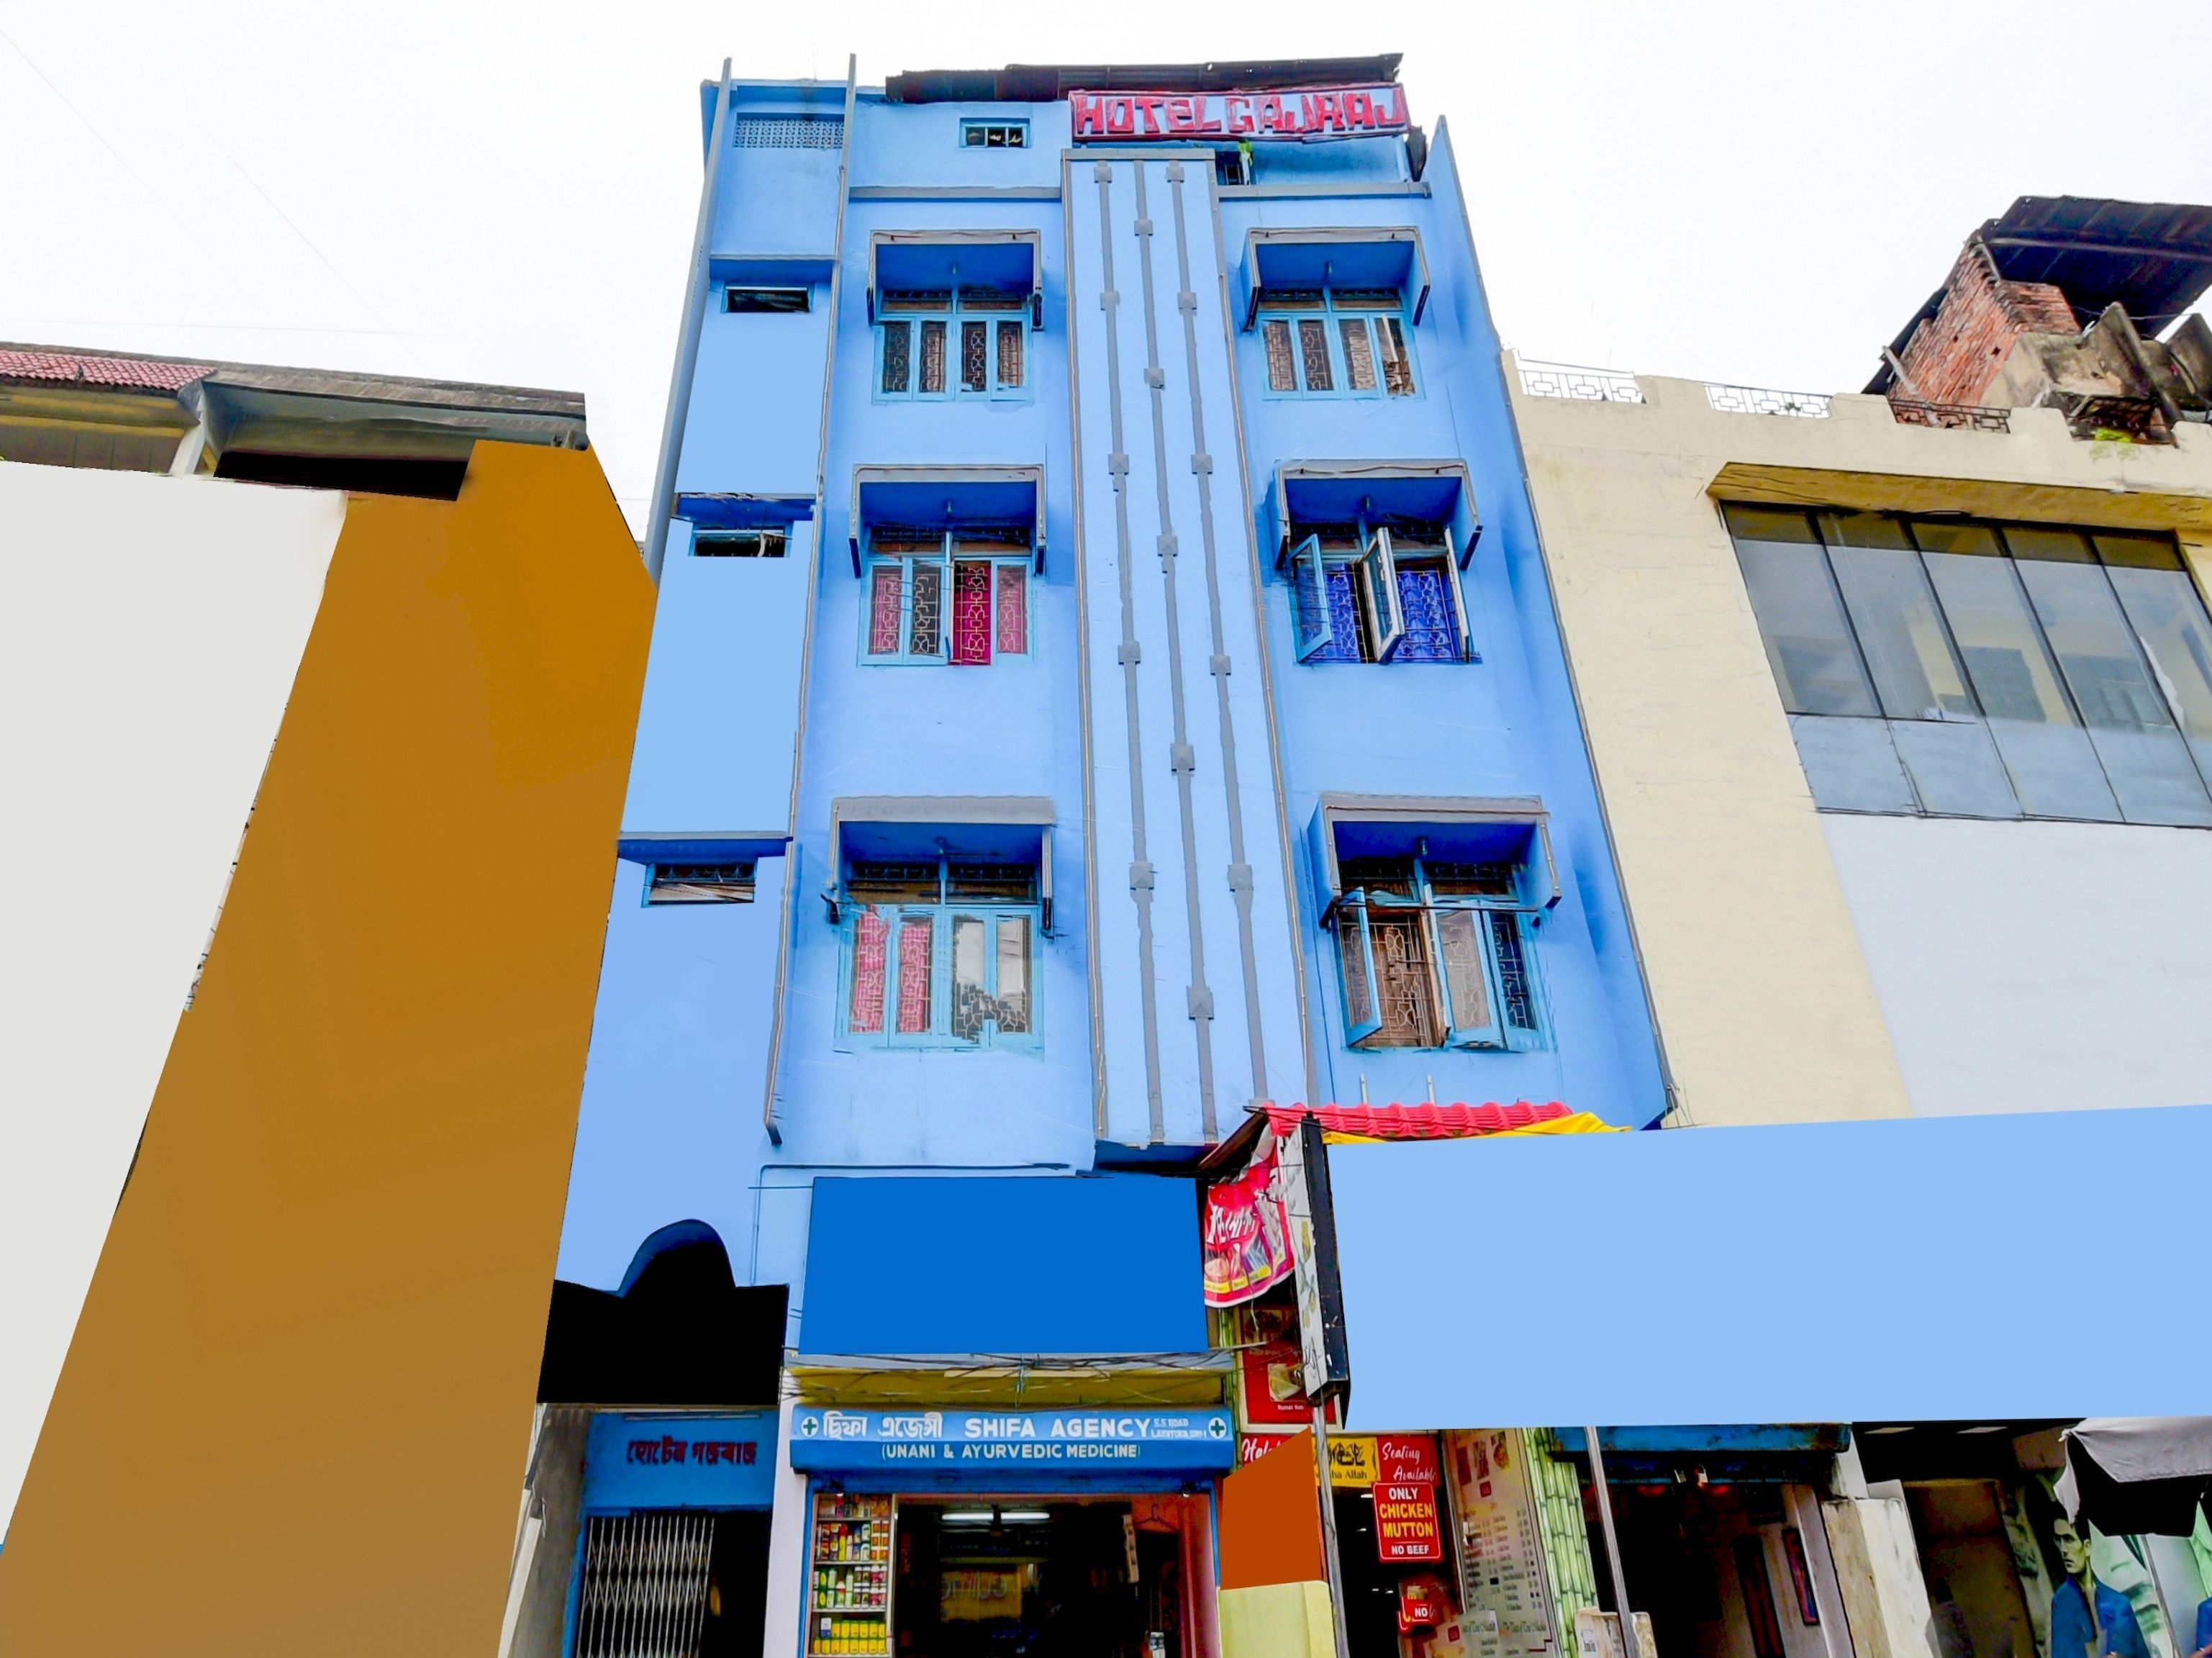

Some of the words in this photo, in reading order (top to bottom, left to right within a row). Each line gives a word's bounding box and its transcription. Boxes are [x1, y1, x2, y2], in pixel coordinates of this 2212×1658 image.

[1076, 94, 1222, 134] HOTEL
[1225, 87, 1406, 135] GAJRAJ
[964, 1418, 1036, 1438] SHIFA
[1051, 1418, 1151, 1438] AGENCY
[881, 1444, 935, 1459] (UNANI
[943, 1445, 954, 1459] &
[961, 1444, 1062, 1459] AYURVEDIC
[1066, 1444, 1141, 1458] MEDICINE)
[1382, 1441, 1420, 1464] Seating
[1346, 1469, 1367, 1480] Allah
[1389, 1487, 1418, 1500] ONLY
[1379, 1503, 1433, 1518] CHICKEN
[1383, 1522, 1433, 1538] MUTTON
[1391, 1545, 1405, 1555] NO
[1407, 1544, 1429, 1554] BEEF
